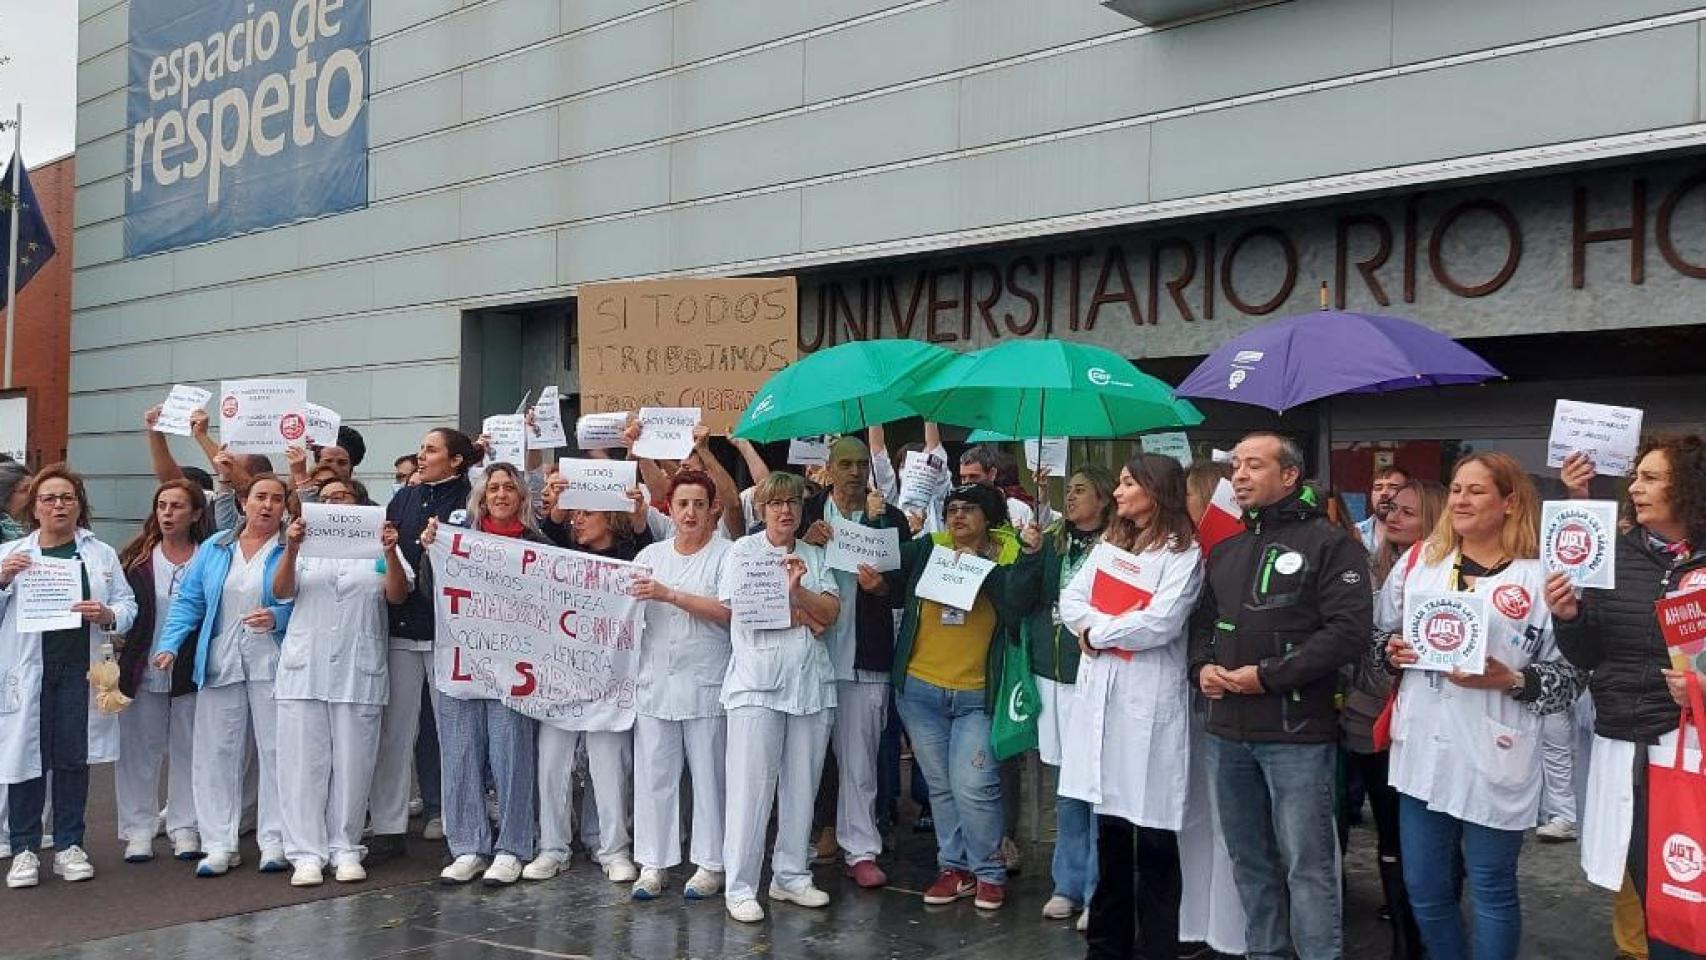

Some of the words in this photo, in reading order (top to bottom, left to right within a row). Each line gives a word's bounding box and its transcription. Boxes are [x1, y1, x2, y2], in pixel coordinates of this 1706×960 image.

[148, 3, 281, 109] espacio
[289, 0, 344, 49] de
[131, 47, 364, 203] respeto
[596, 296, 628, 334] SI
[640, 287, 788, 329] TODOS
[798, 226, 1299, 354] UNIVERSITARIO
[1560, 530, 1587, 547] UGT
[1430, 618, 1461, 636] UGT
[1668, 840, 1695, 862] UGT
